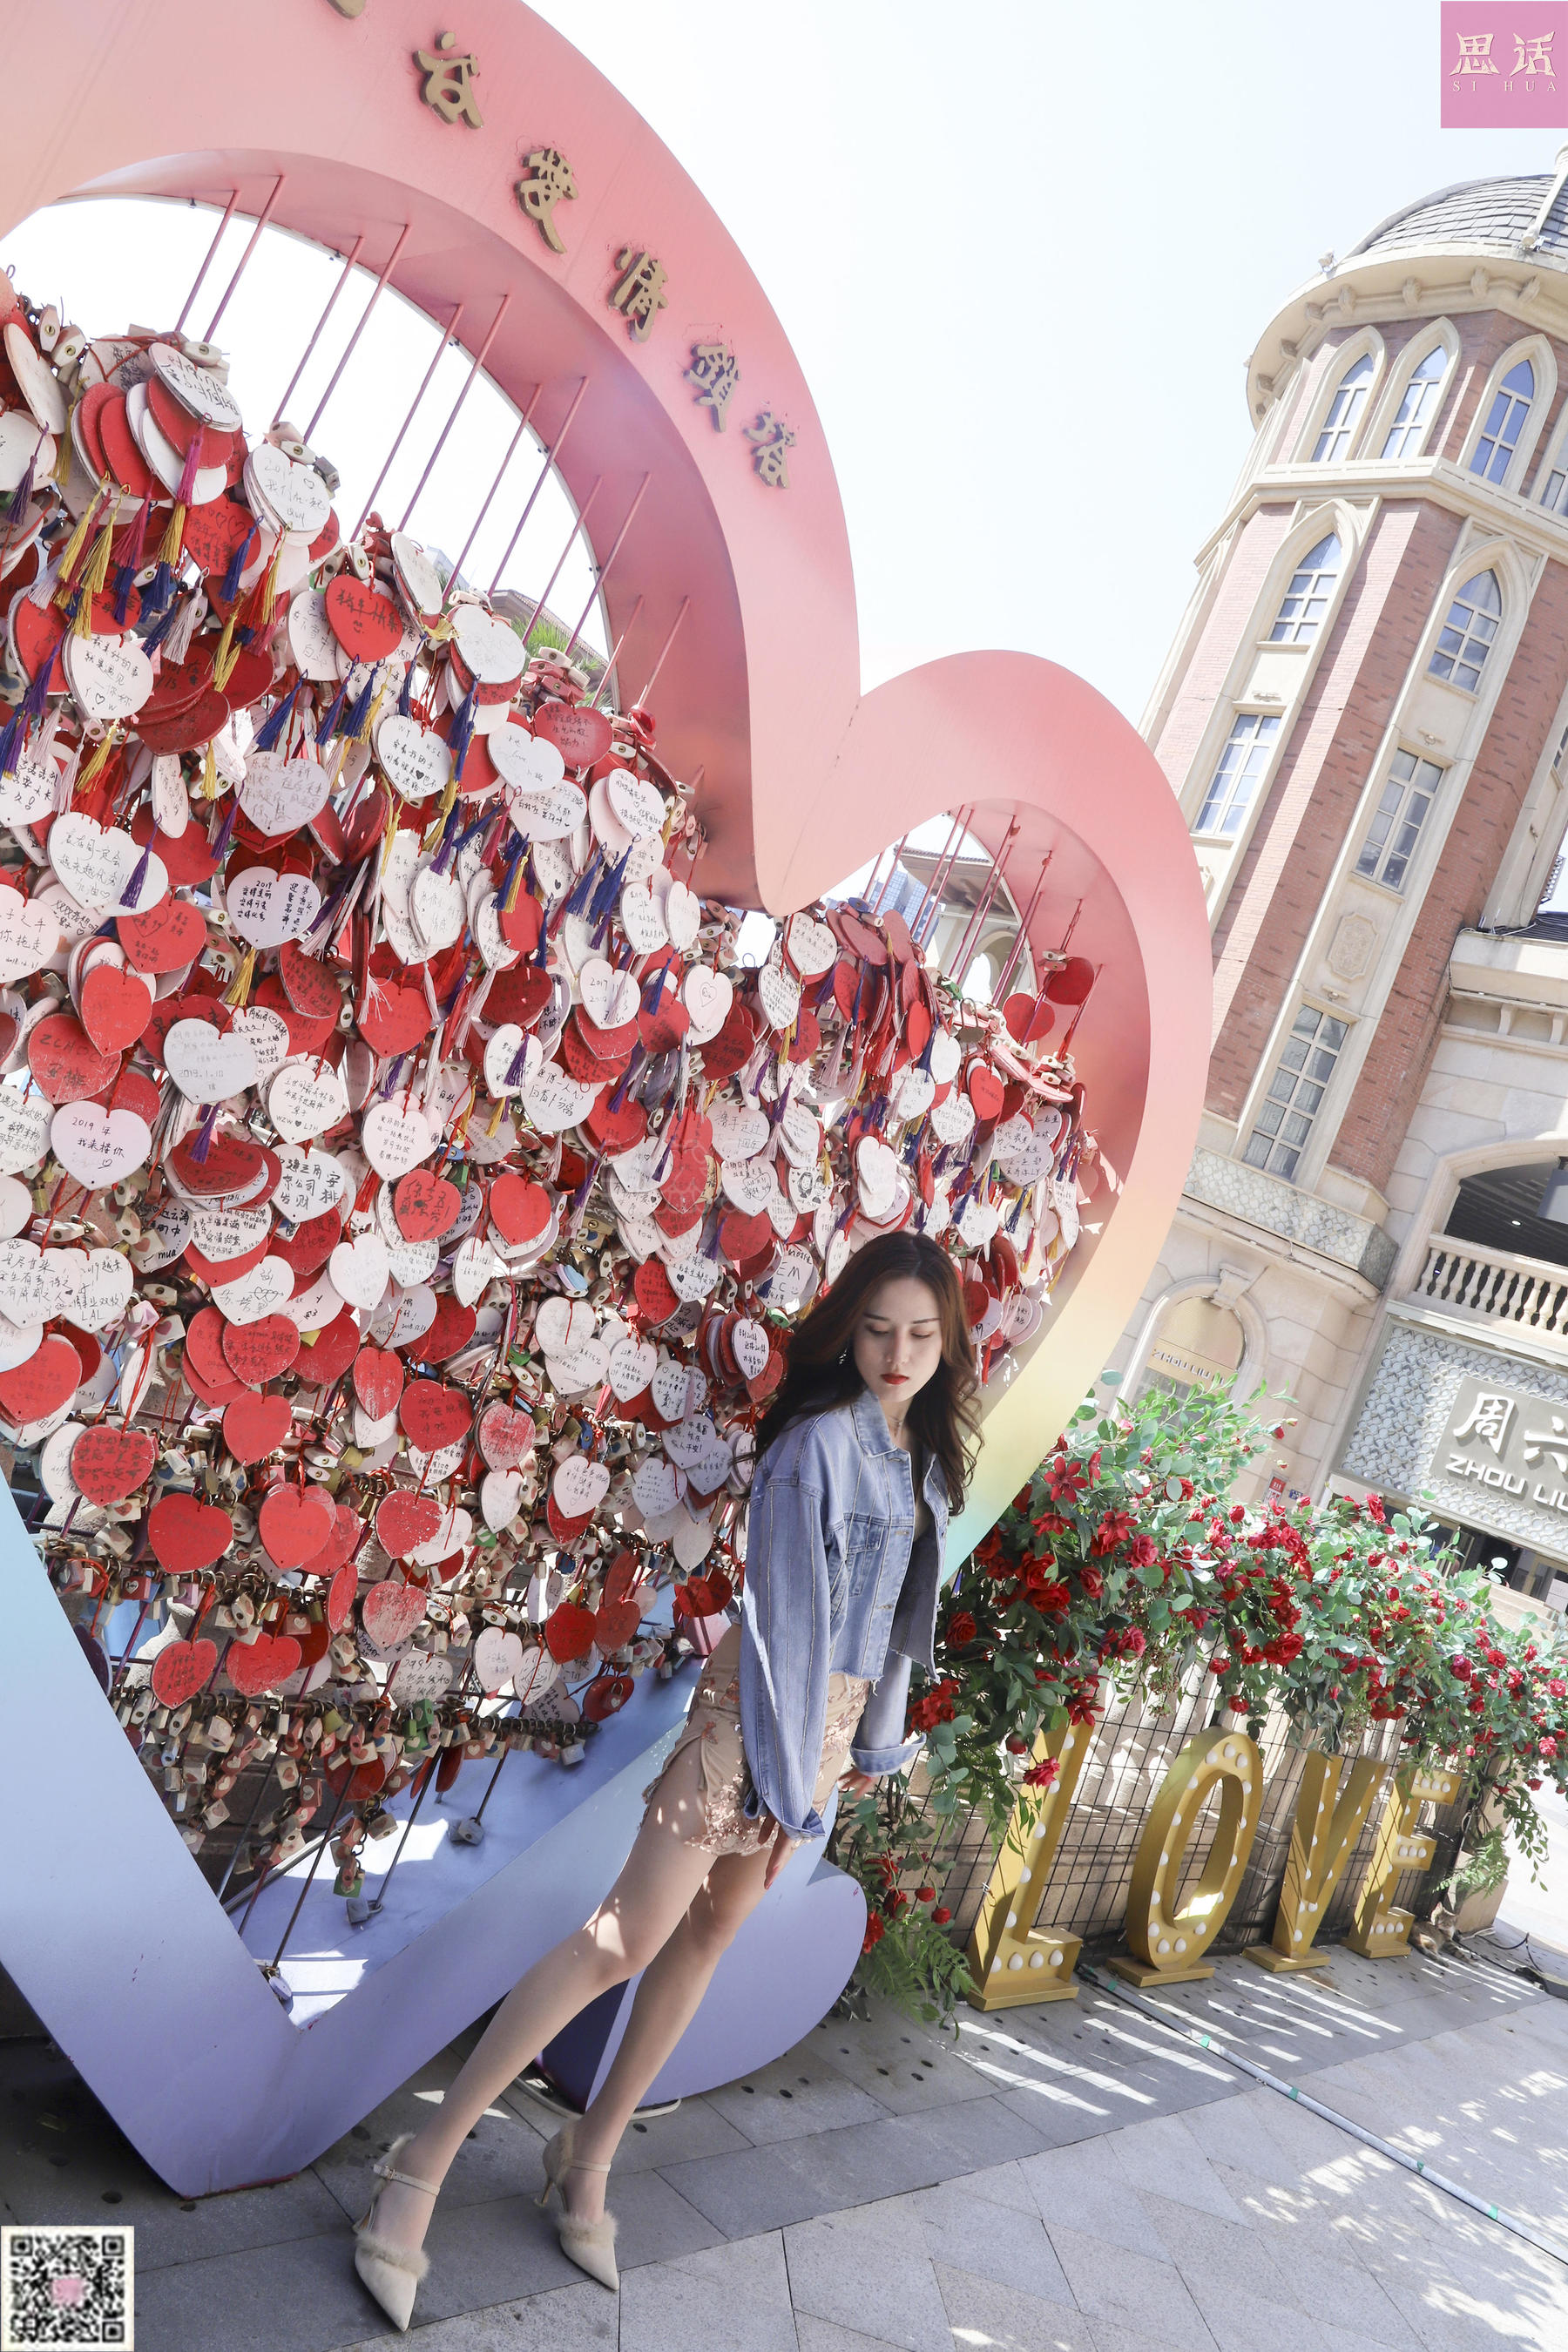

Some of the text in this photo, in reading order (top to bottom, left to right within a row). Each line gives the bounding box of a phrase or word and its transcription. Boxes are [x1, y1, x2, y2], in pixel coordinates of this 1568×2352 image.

[72, 1117, 94, 1131] 2019
[1453, 1392, 1568, 1473] 周六
[1445, 1453, 1525, 1495] ZHOU
[967, 1714, 1463, 2010] LOVE
